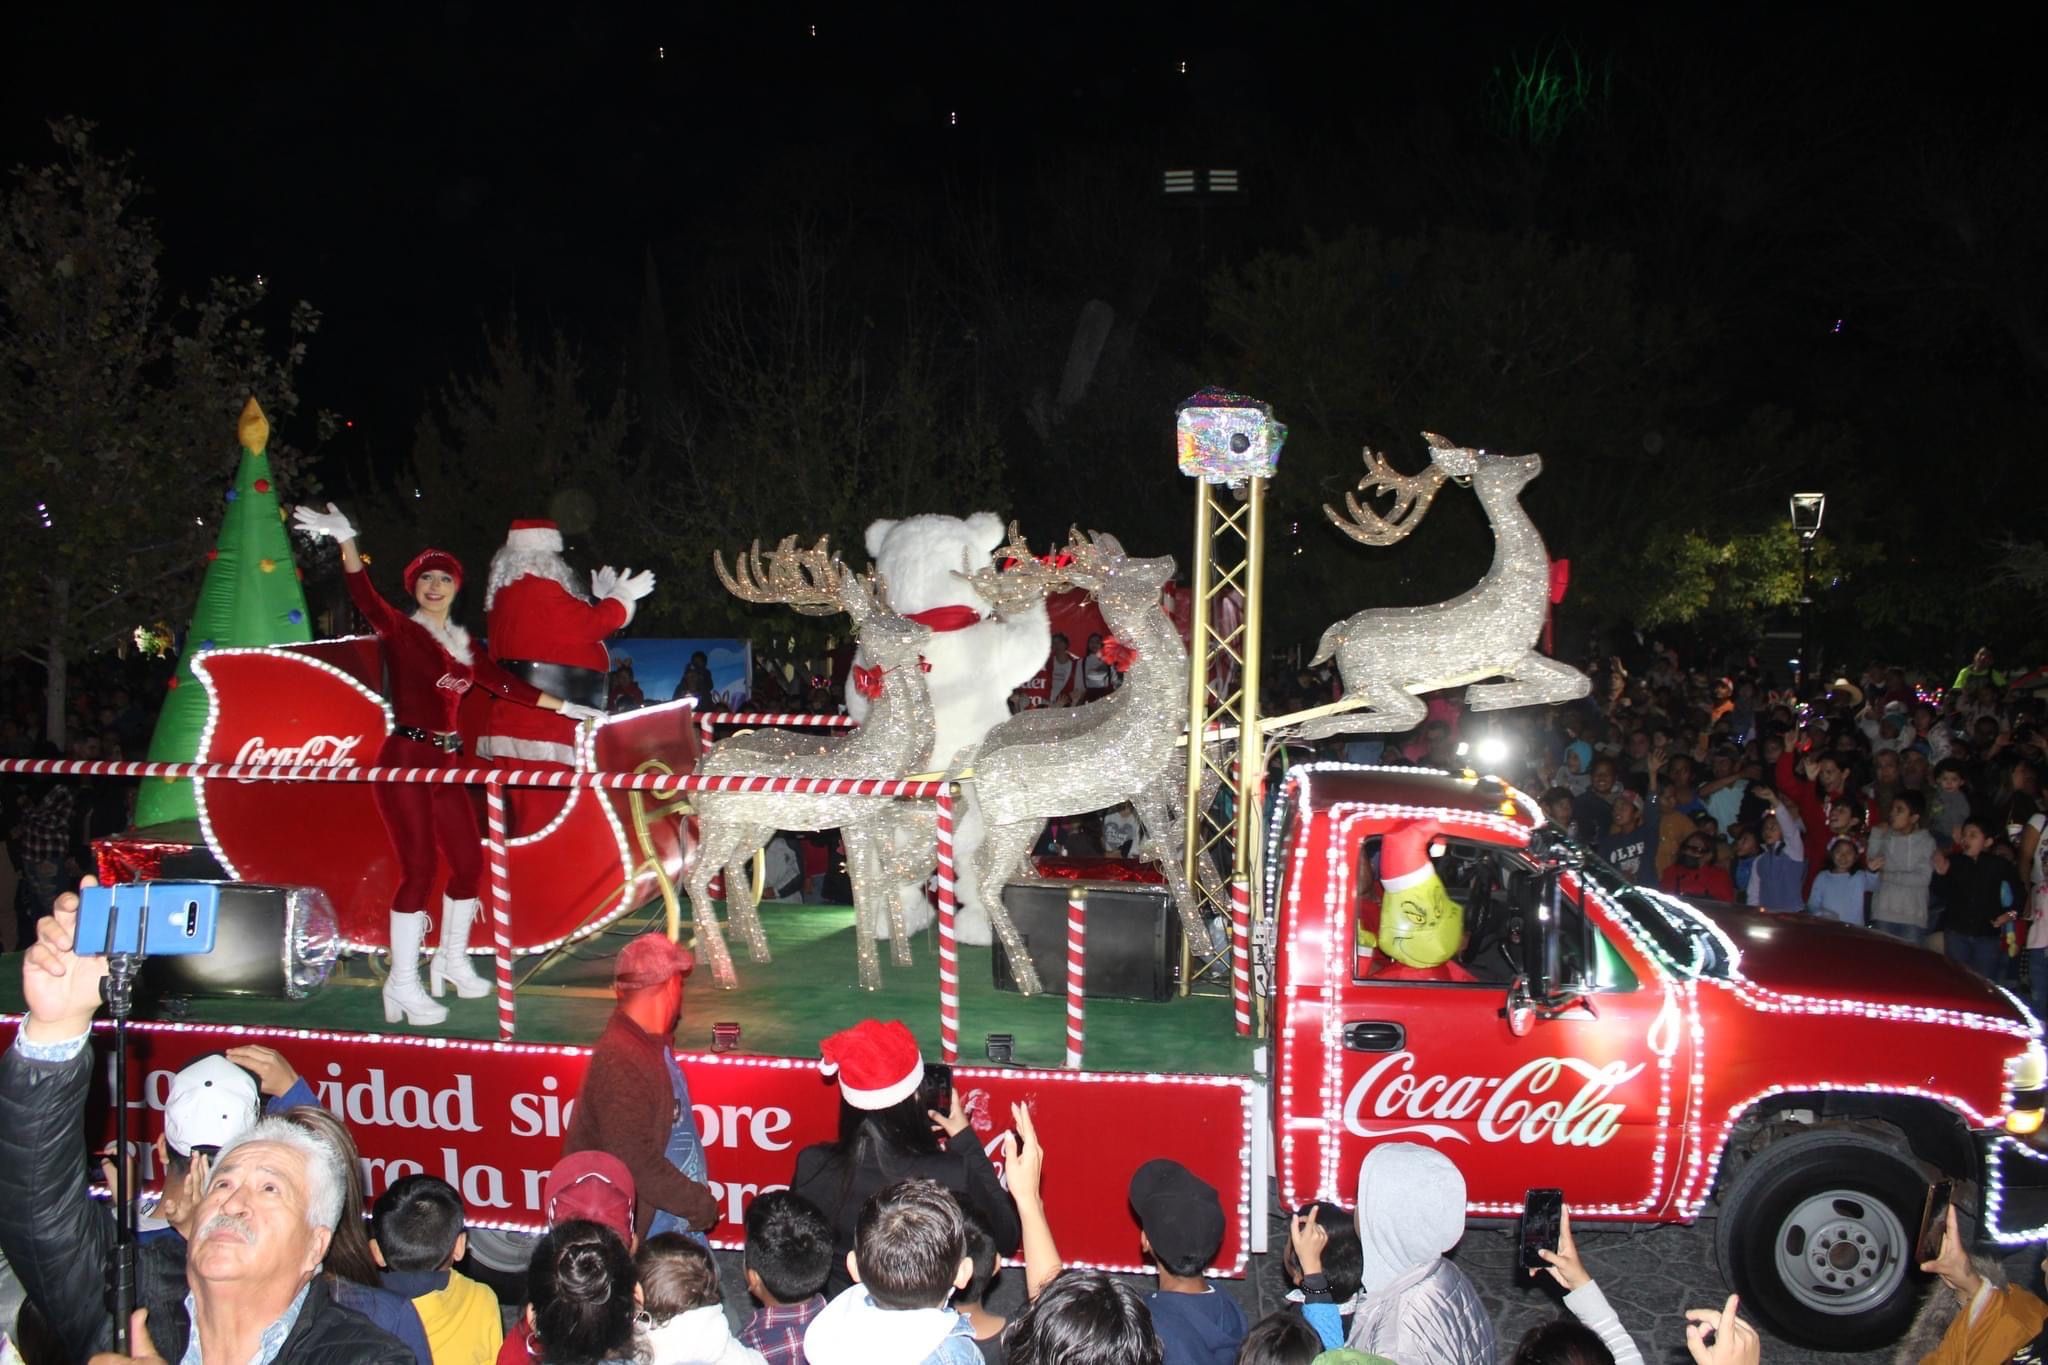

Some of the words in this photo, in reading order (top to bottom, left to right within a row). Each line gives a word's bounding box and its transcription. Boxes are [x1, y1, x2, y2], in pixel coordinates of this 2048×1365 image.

[510, 1076, 792, 1151] sire
[1343, 1051, 1647, 1147] Coca-Cola
[440, 1147, 513, 1209] la
